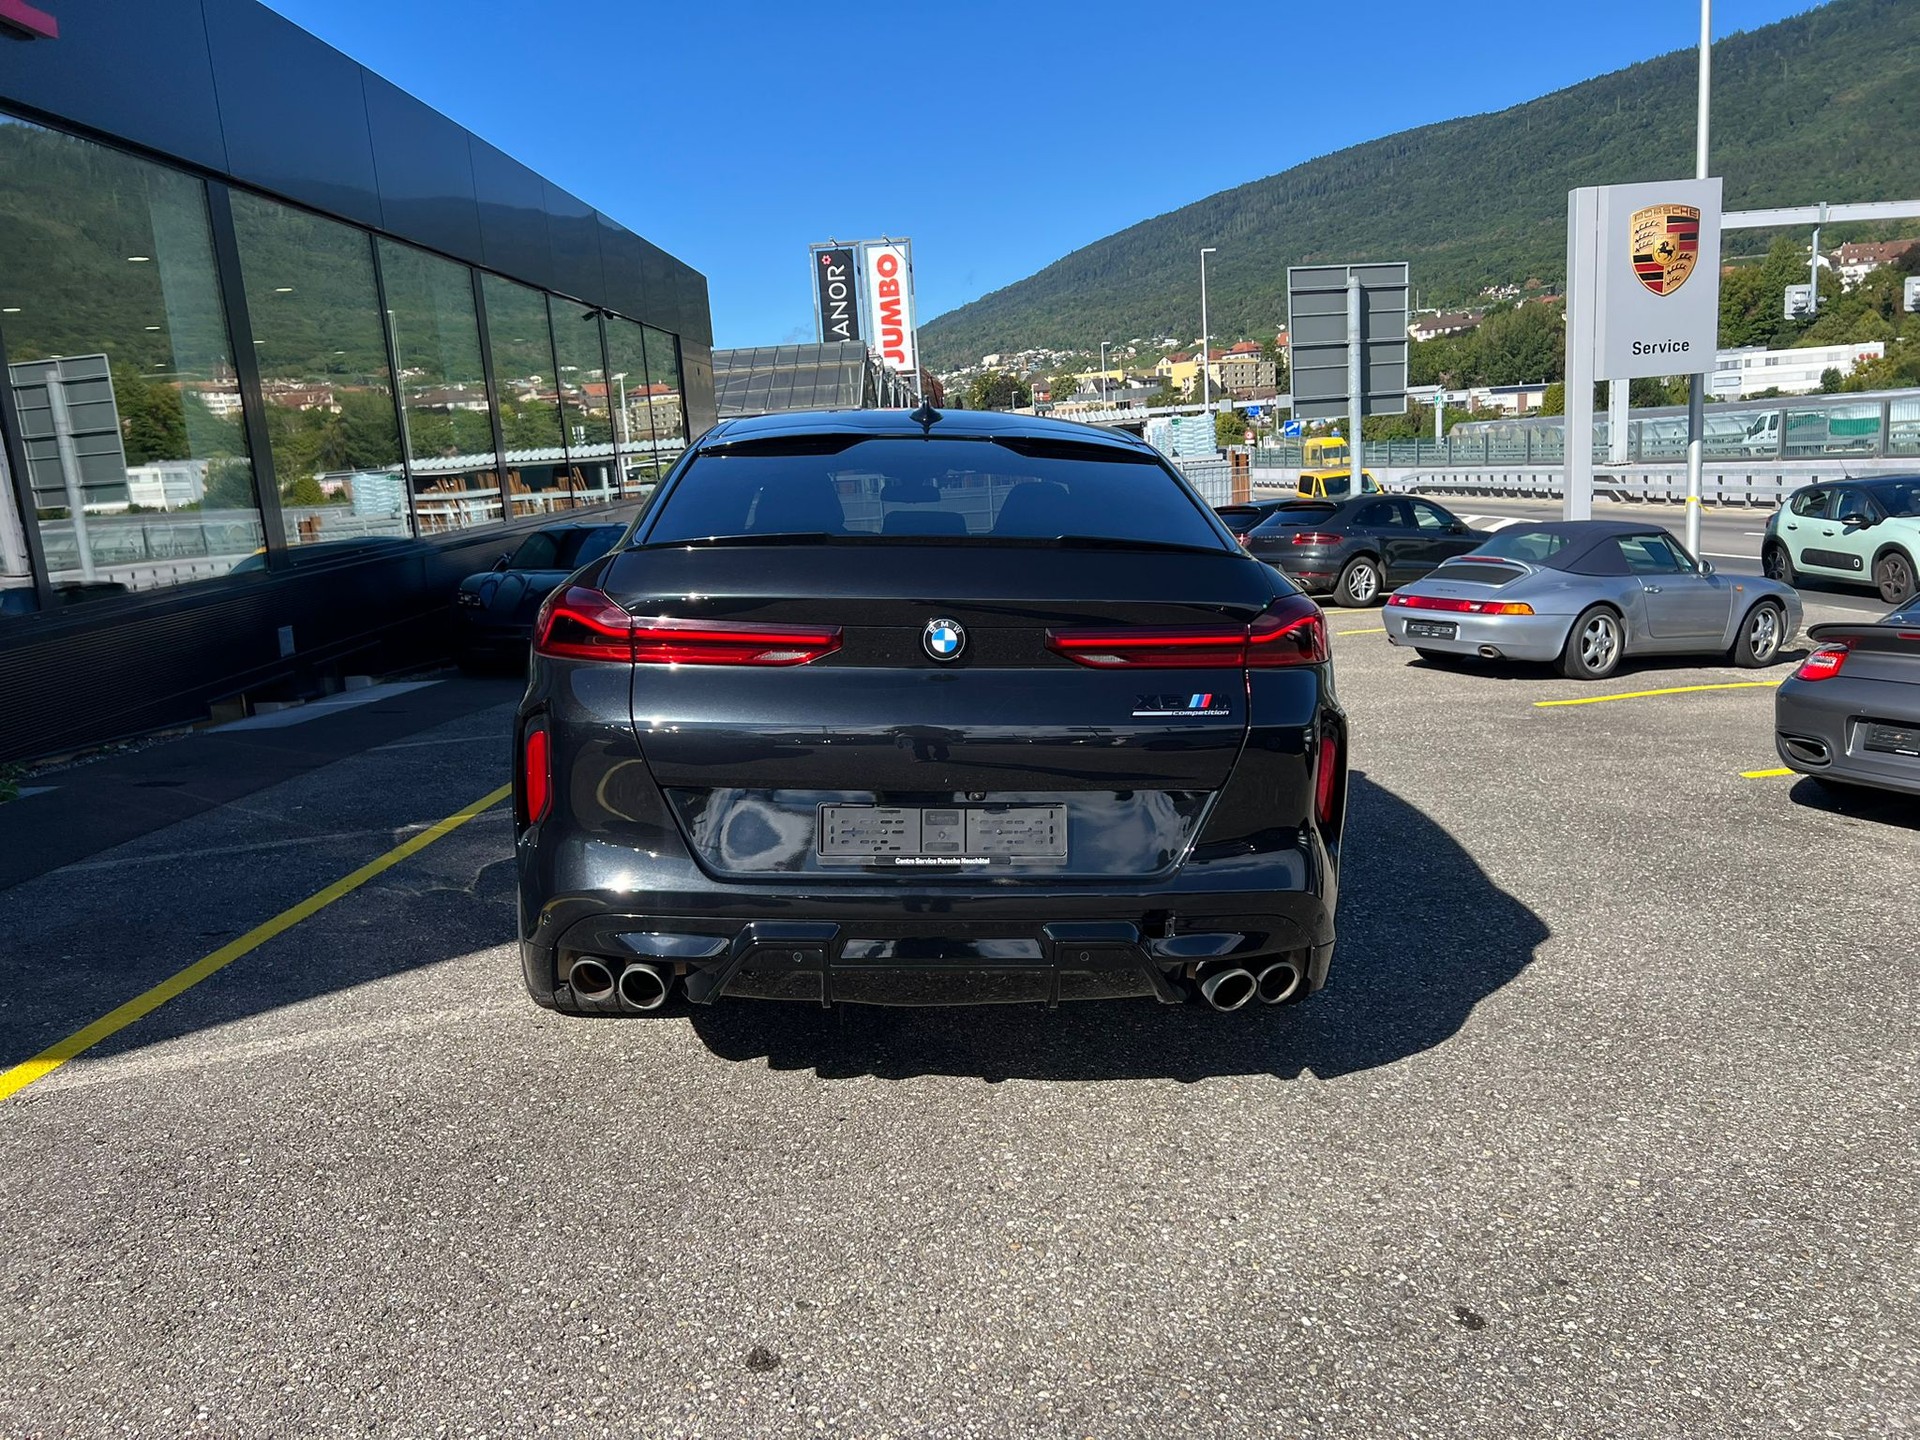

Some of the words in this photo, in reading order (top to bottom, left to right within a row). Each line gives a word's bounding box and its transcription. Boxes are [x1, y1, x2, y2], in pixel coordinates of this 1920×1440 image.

[1635, 206, 1698, 221] PORSCHE
[827, 264, 851, 342] ANOR
[877, 254, 905, 364] JUMBO
[1632, 339, 1690, 355] Service
[928, 621, 962, 634] BMW
[915, 857, 937, 865] Service
[937, 857, 960, 865] Porsche
